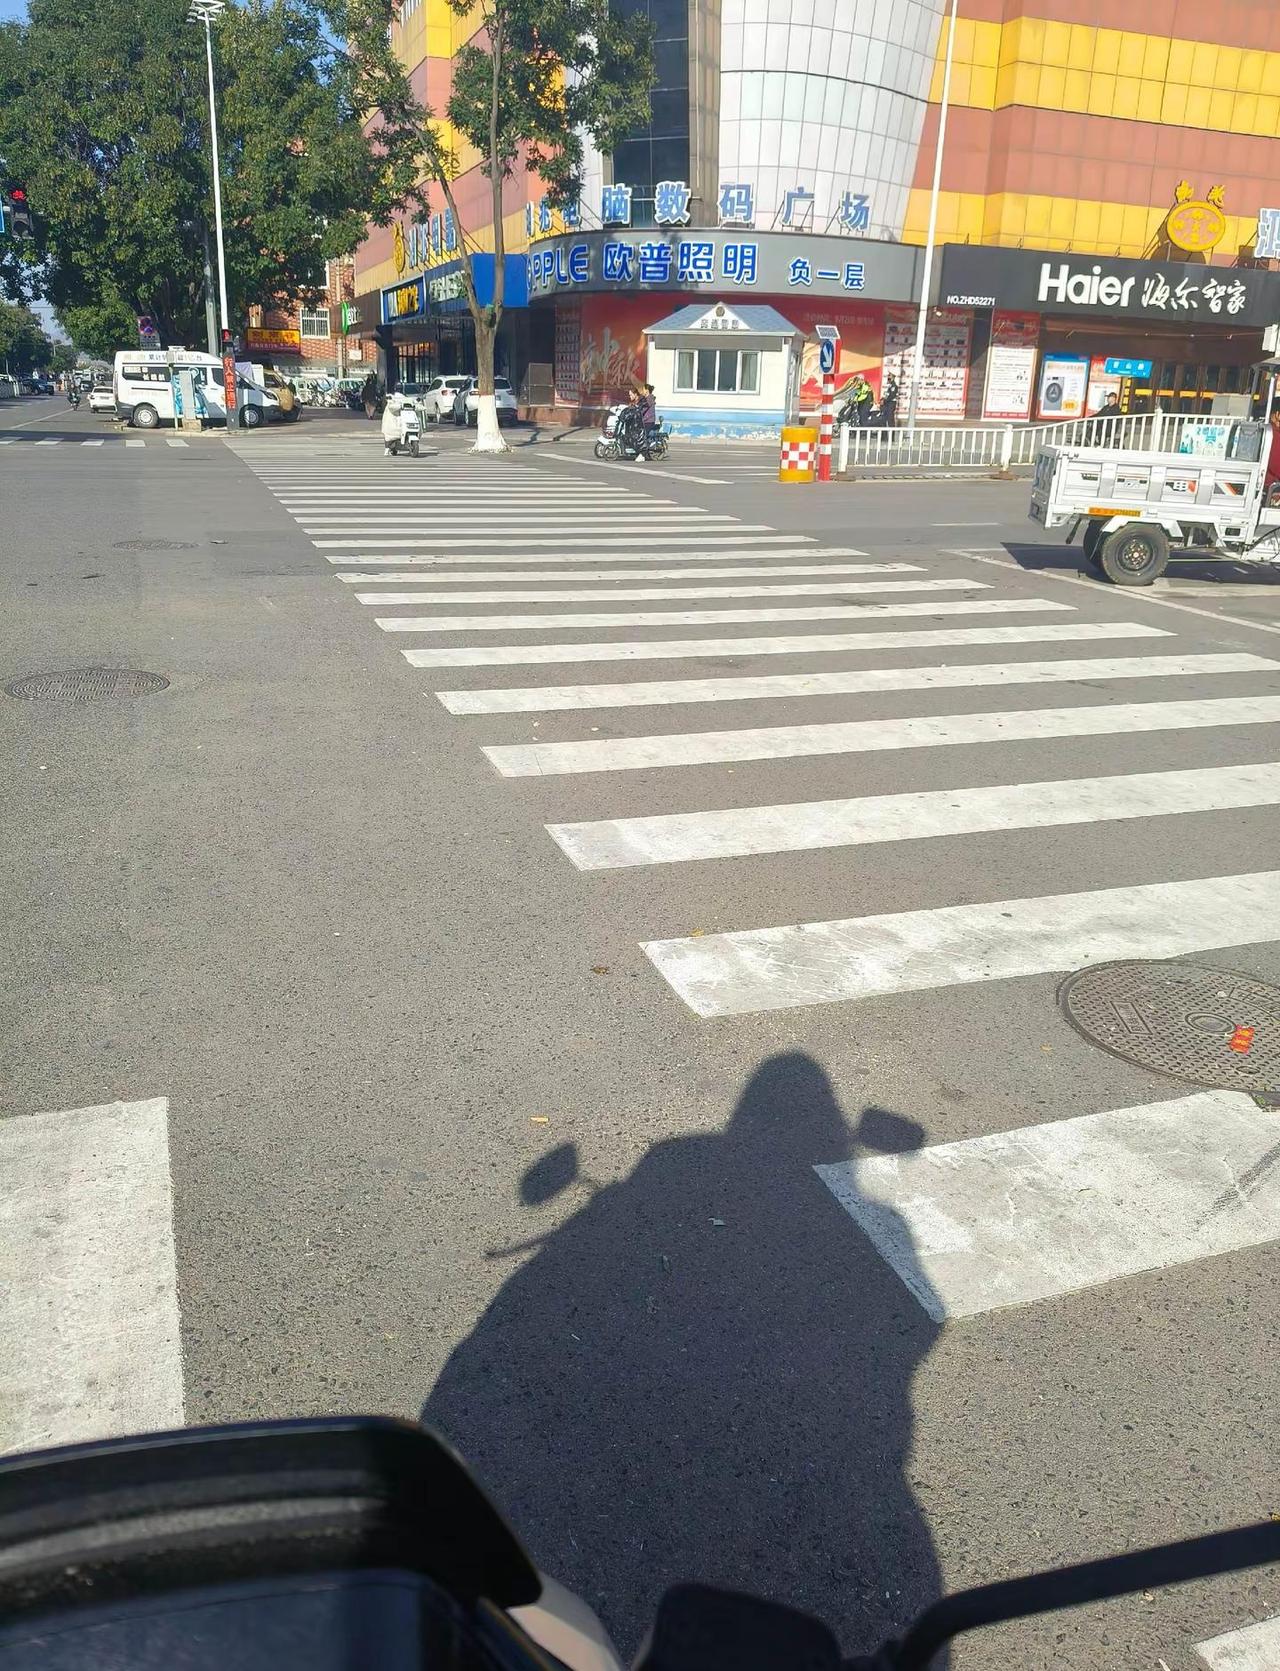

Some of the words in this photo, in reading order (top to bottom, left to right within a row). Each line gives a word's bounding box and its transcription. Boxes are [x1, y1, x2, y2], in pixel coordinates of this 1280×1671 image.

[603, 242, 759, 285] 欧普照明
[789, 257, 866, 290] 负一层
[1037, 263, 1135, 307] Haier
[1141, 272, 1247, 314] 海尔智家
[223, 356, 237, 410] 行人禁止通行
